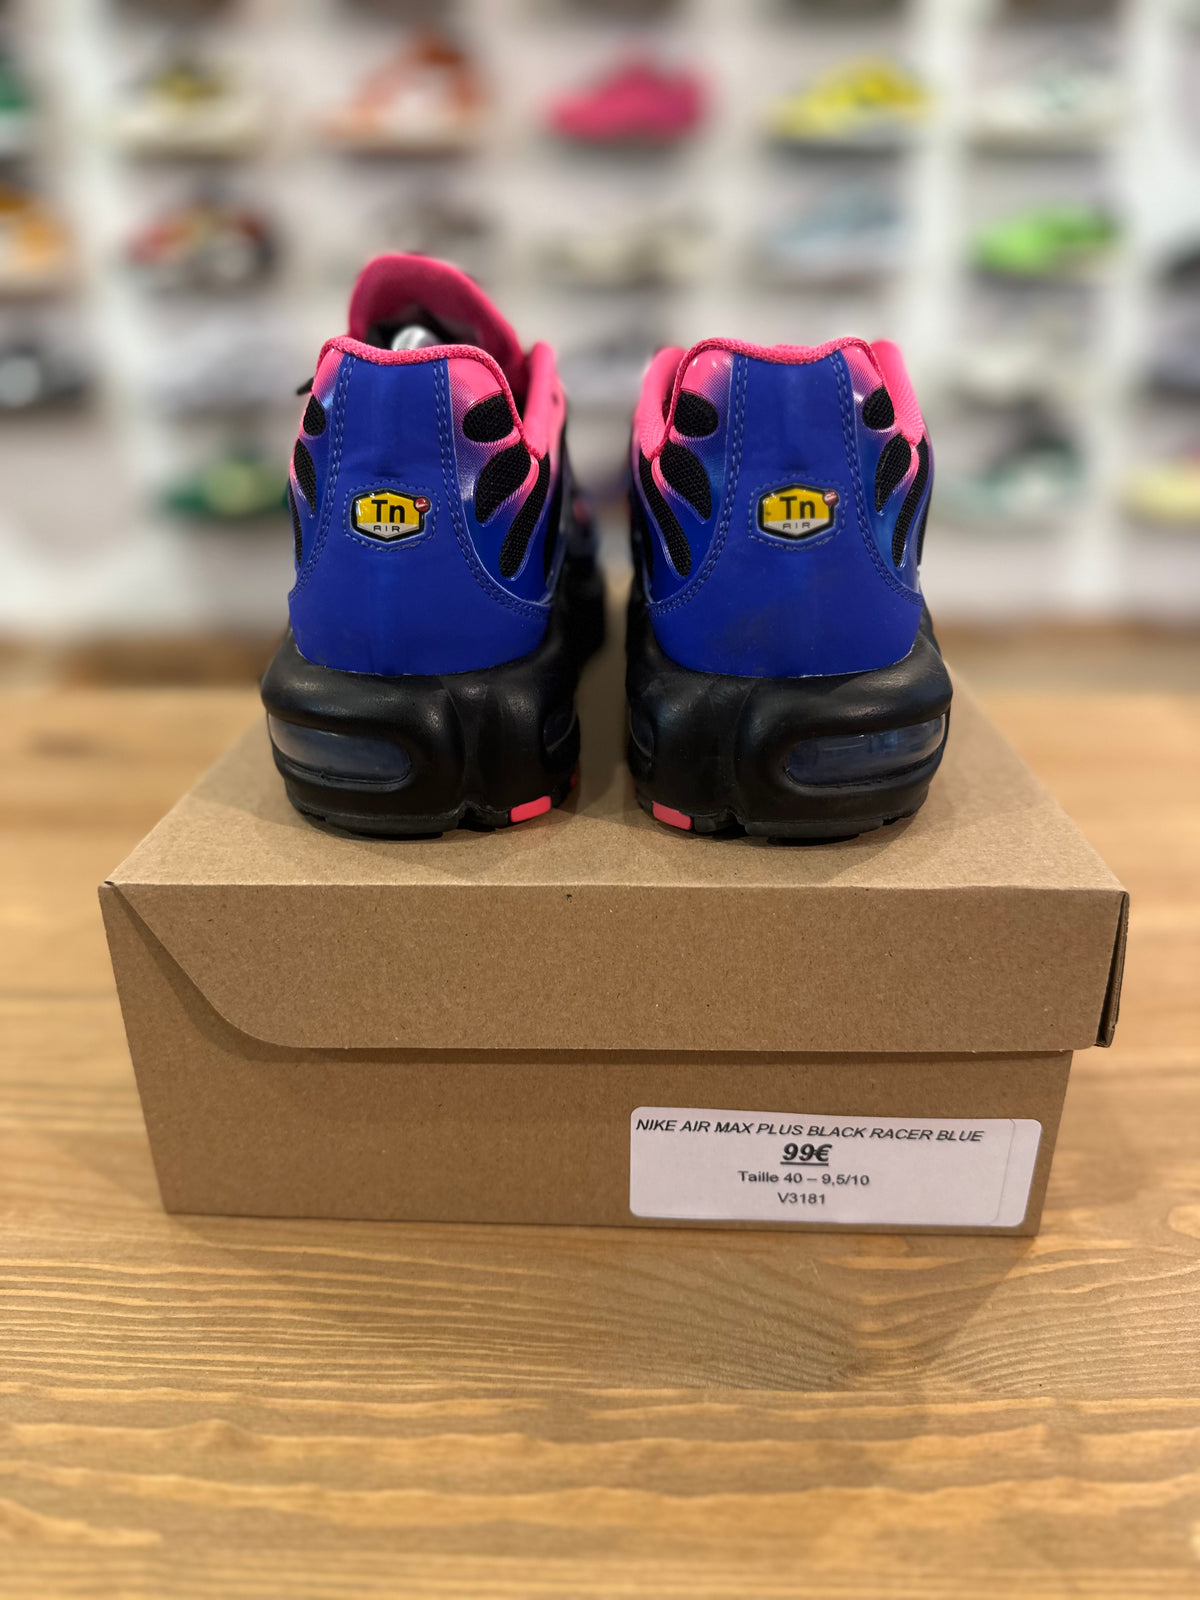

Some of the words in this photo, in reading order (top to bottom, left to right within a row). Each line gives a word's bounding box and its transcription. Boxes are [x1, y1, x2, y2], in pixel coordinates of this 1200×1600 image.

[371, 499, 405, 523] Tn
[779, 496, 815, 520] Tn
[782, 522, 811, 530] AIR
[636, 1119, 677, 1132] NIKE
[680, 1120, 711, 1133] AIR
[714, 1121, 753, 1134] MAX
[756, 1123, 803, 1136] PLUS
[806, 1125, 867, 1139] BLACK
[869, 1127, 933, 1141] RACER
[936, 1130, 984, 1142] BLUE
[781, 1143, 832, 1163] 99€
[738, 1170, 779, 1183] Taille
[783, 1172, 802, 1184] 40
[821, 1174, 870, 1187] 9,5/10
[777, 1192, 826, 1205] V3181
